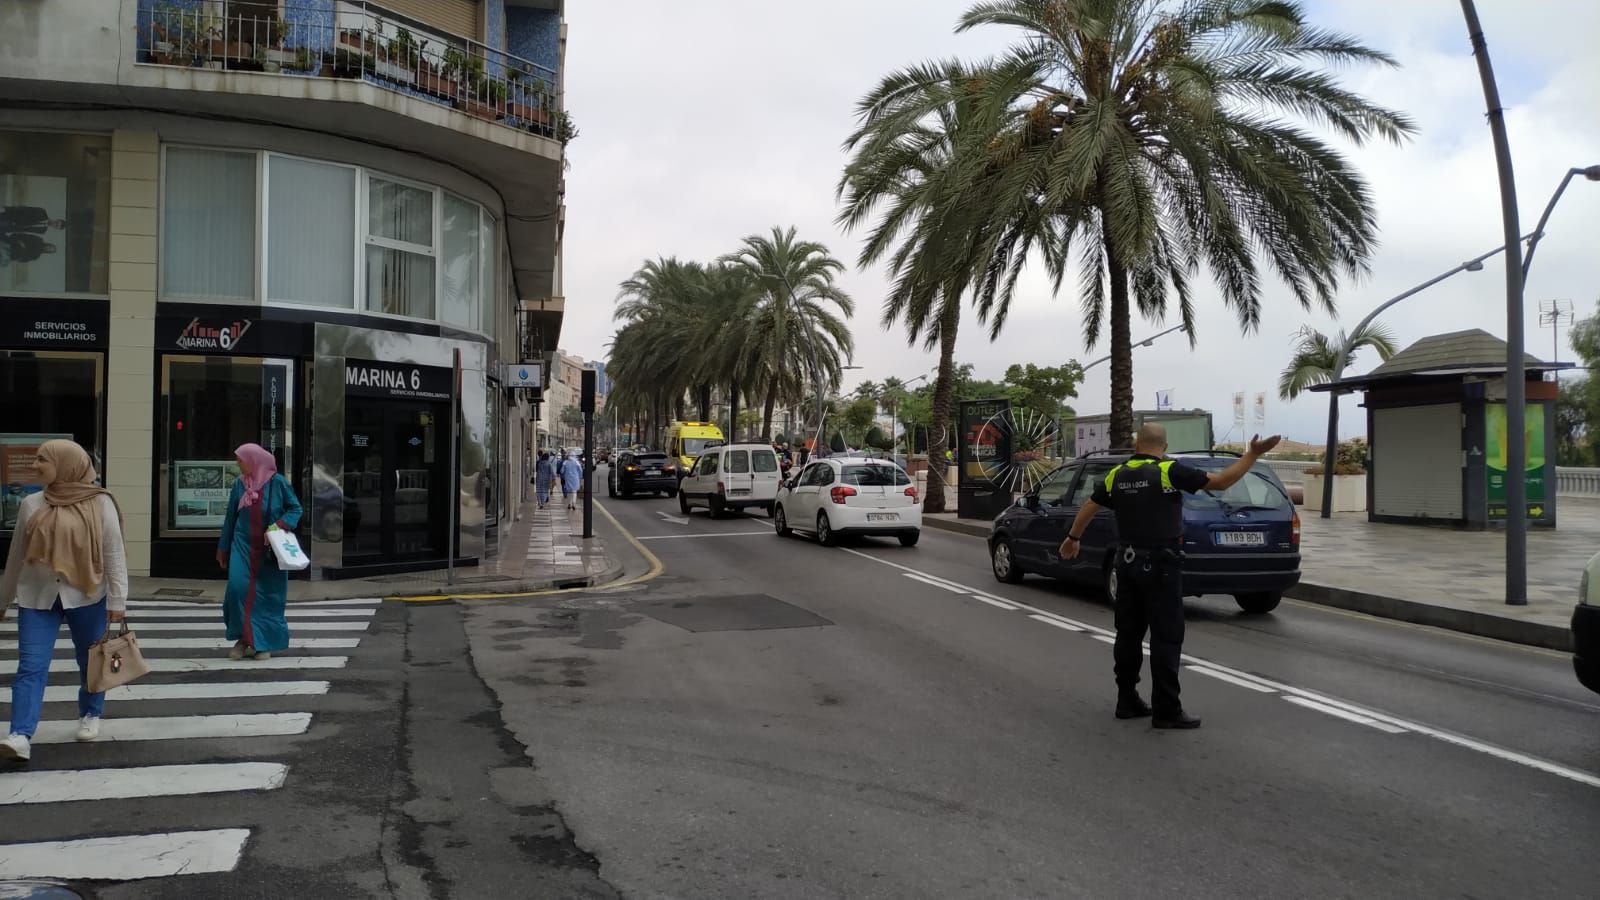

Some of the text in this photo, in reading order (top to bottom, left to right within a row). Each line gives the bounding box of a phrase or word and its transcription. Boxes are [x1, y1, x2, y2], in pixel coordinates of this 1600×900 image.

[34, 321, 87, 331] SERVICIOS
[23, 331, 97, 341] INMOBILIARIOS
[182, 327, 231, 349] MARINA 6
[345, 366, 421, 390] MARINA 6
[390, 389, 450, 399] SERVICIOS INMOBILIARIOS
[967, 404, 1000, 416] OUTLET
[1224, 533, 1245, 542] 1189
